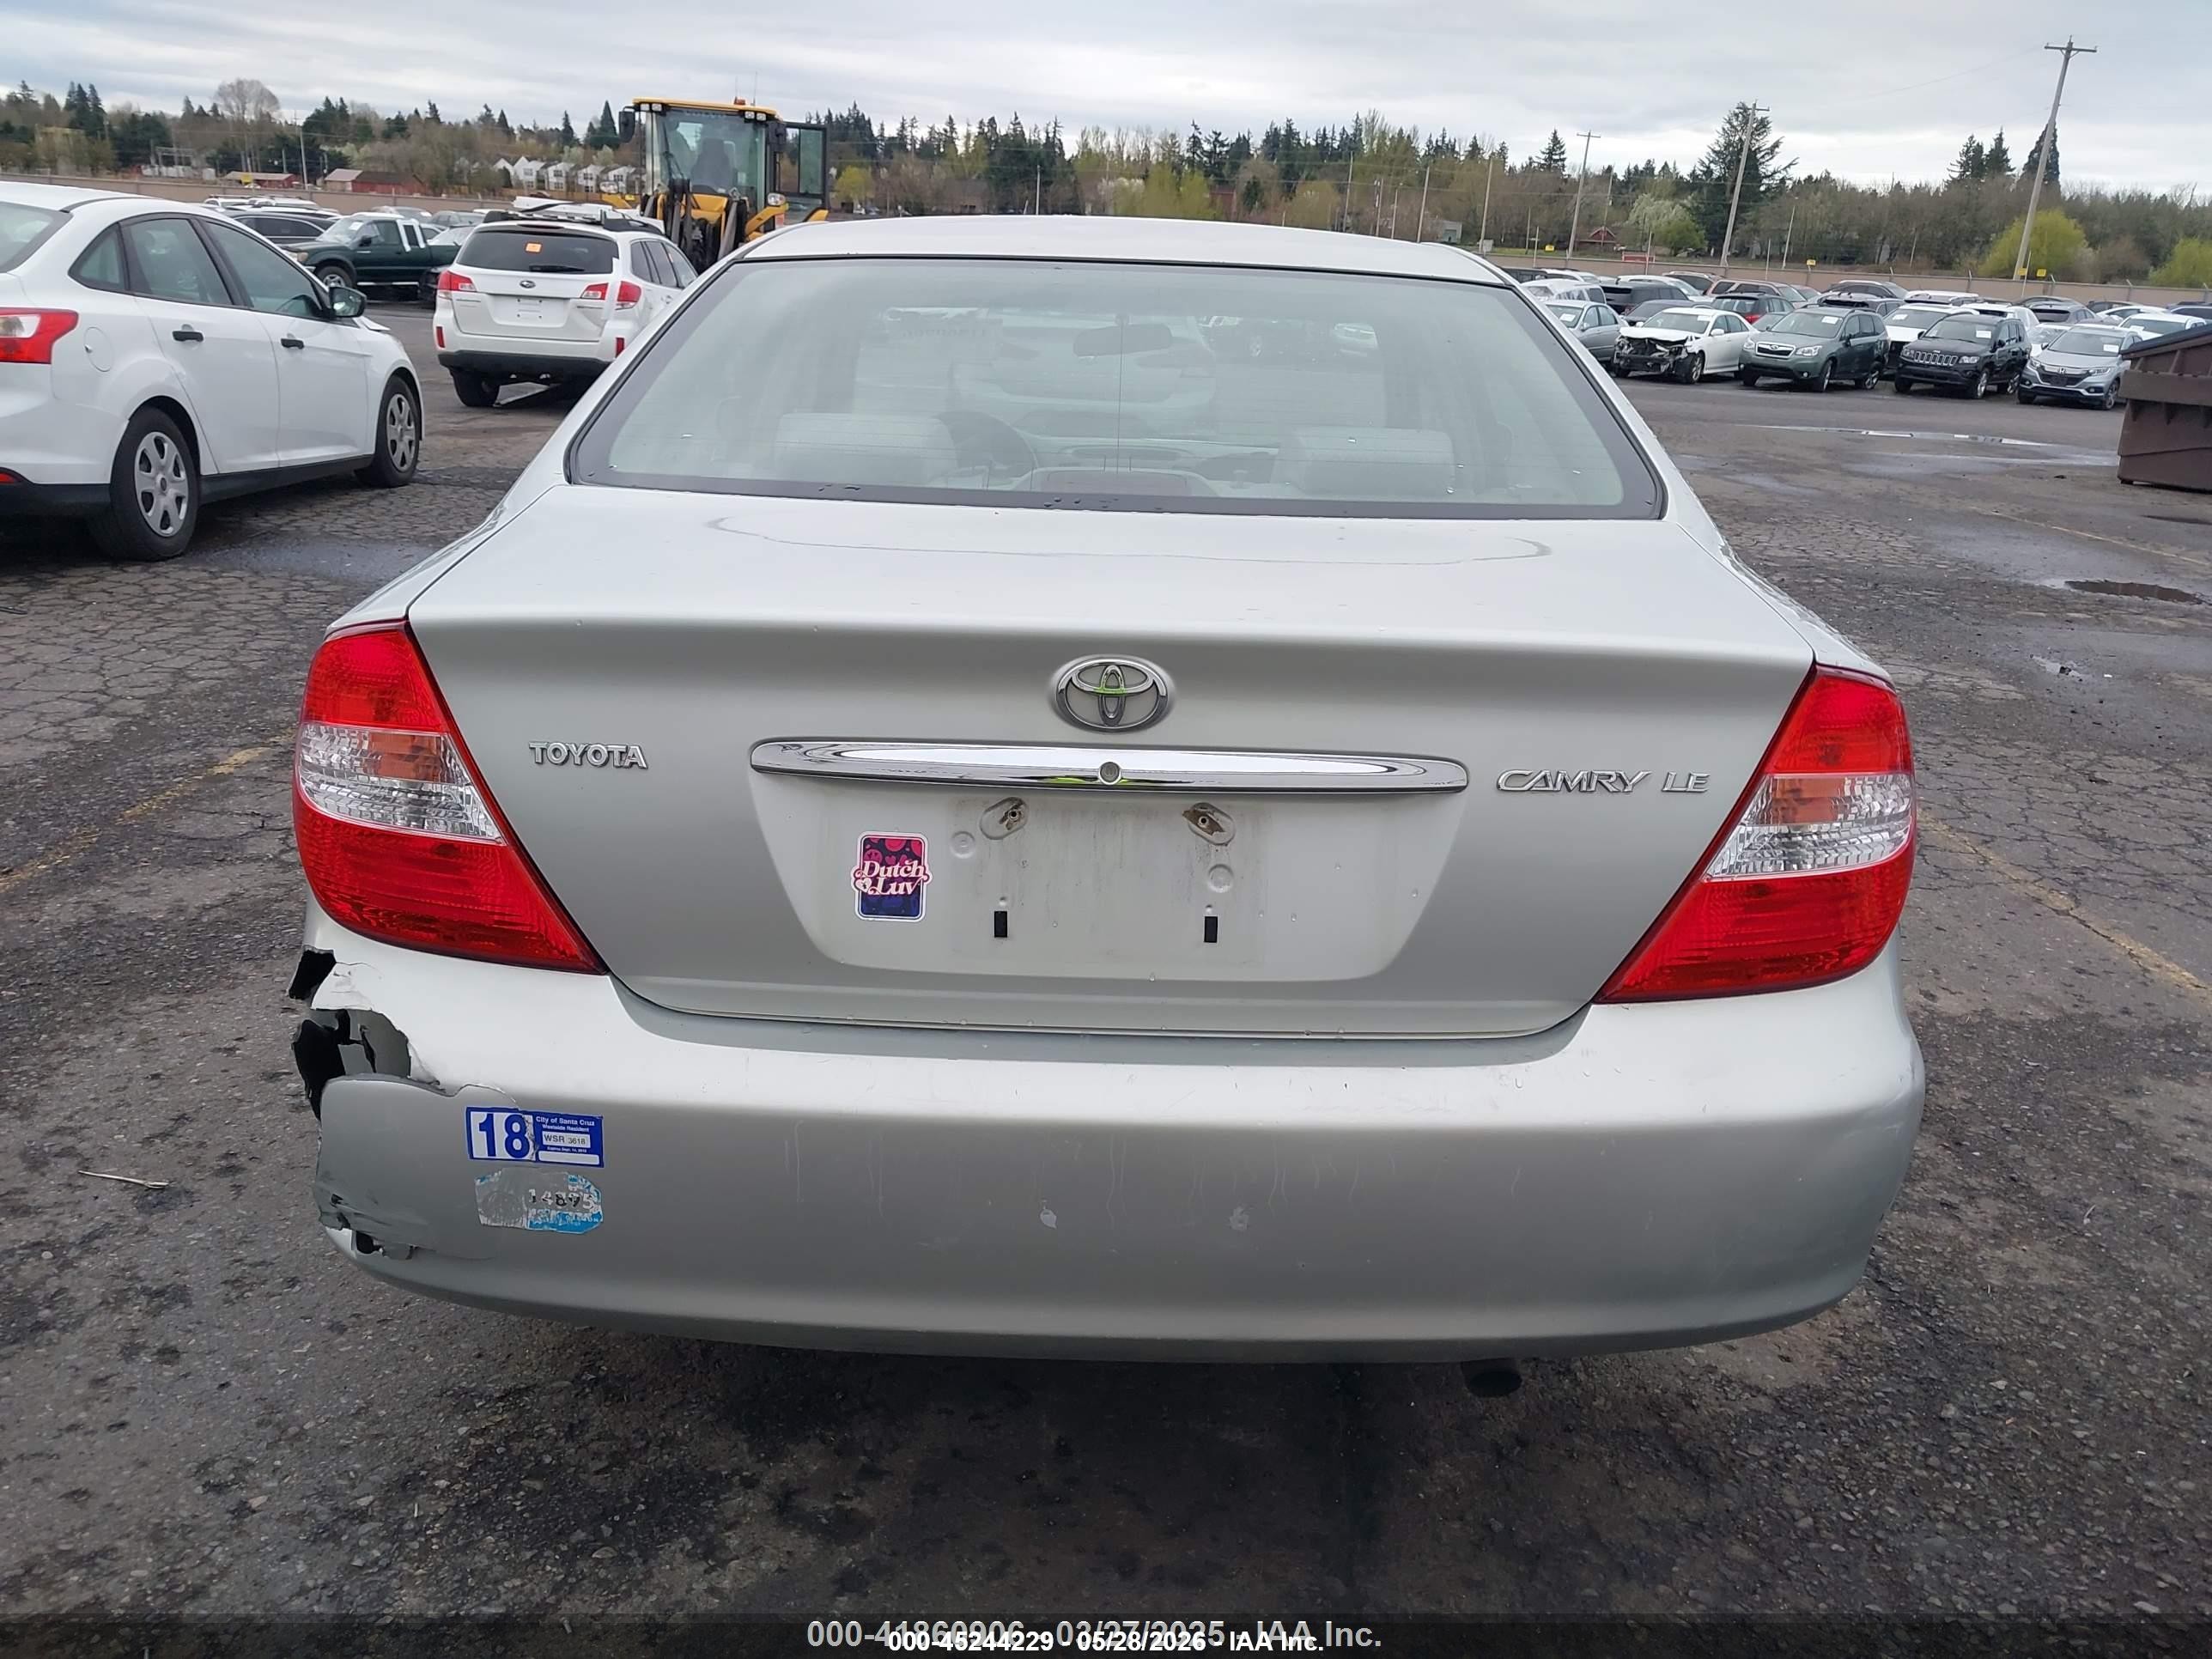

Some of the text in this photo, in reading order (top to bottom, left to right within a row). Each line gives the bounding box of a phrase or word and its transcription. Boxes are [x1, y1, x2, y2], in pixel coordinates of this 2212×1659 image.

[528, 741, 648, 769] TOYOTA
[1497, 769, 1711, 793] CAMRY LE
[860, 860, 926, 878] Dutch
[867, 876, 922, 896] Luv
[478, 1114, 531, 1159] 18
[544, 1134, 565, 1143] WSR
